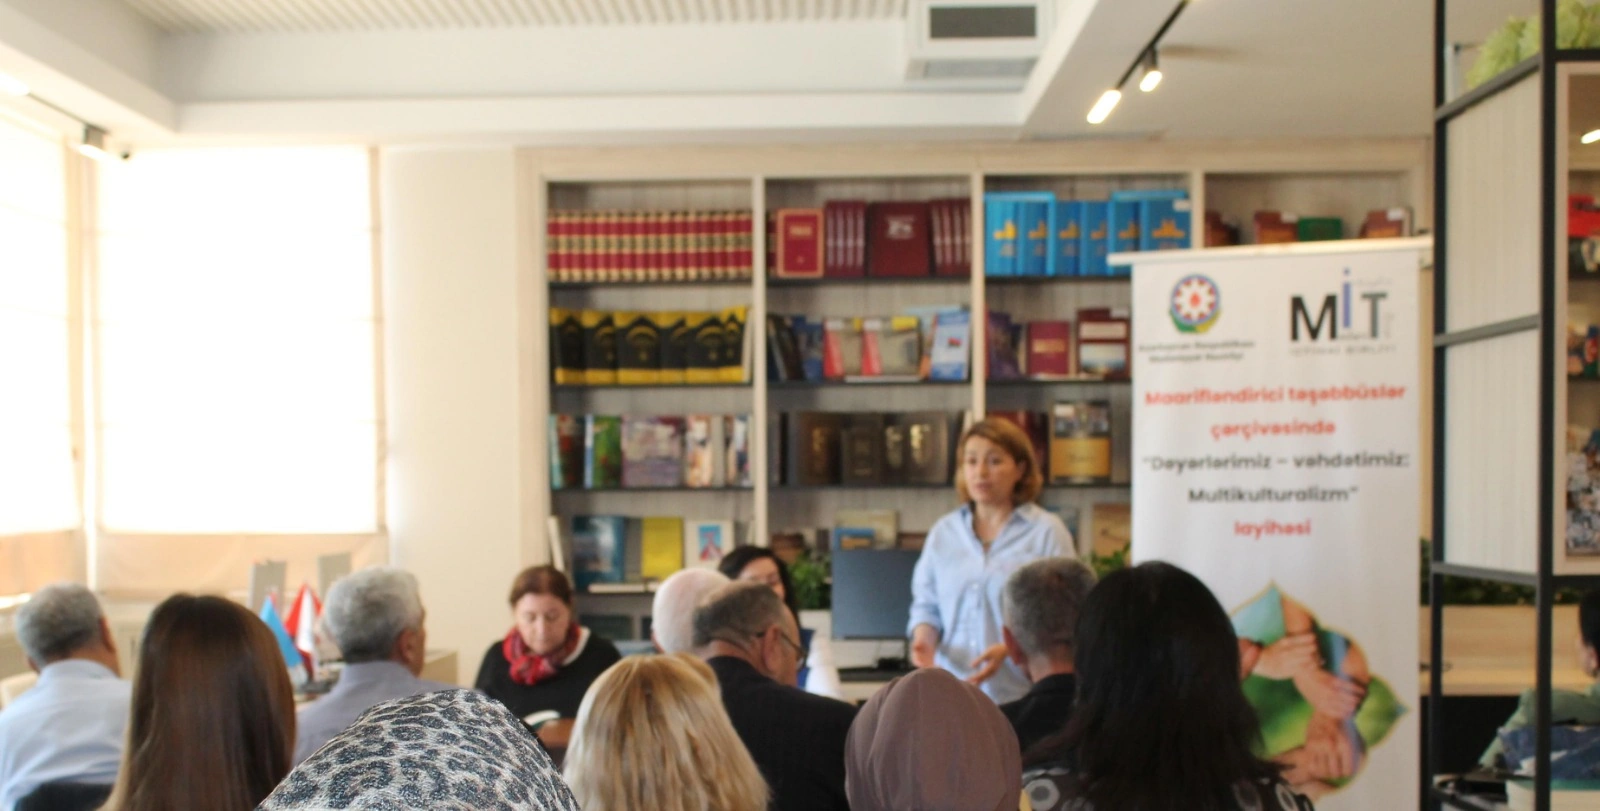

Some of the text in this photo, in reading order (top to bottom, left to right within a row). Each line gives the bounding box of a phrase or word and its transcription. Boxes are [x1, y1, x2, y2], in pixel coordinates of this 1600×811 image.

[1144, 383, 1407, 406] Maarifləndirici təşəbbüslər
[1210, 419, 1337, 441] çərçivəsində
[1234, 519, 1312, 540] layihəsi
